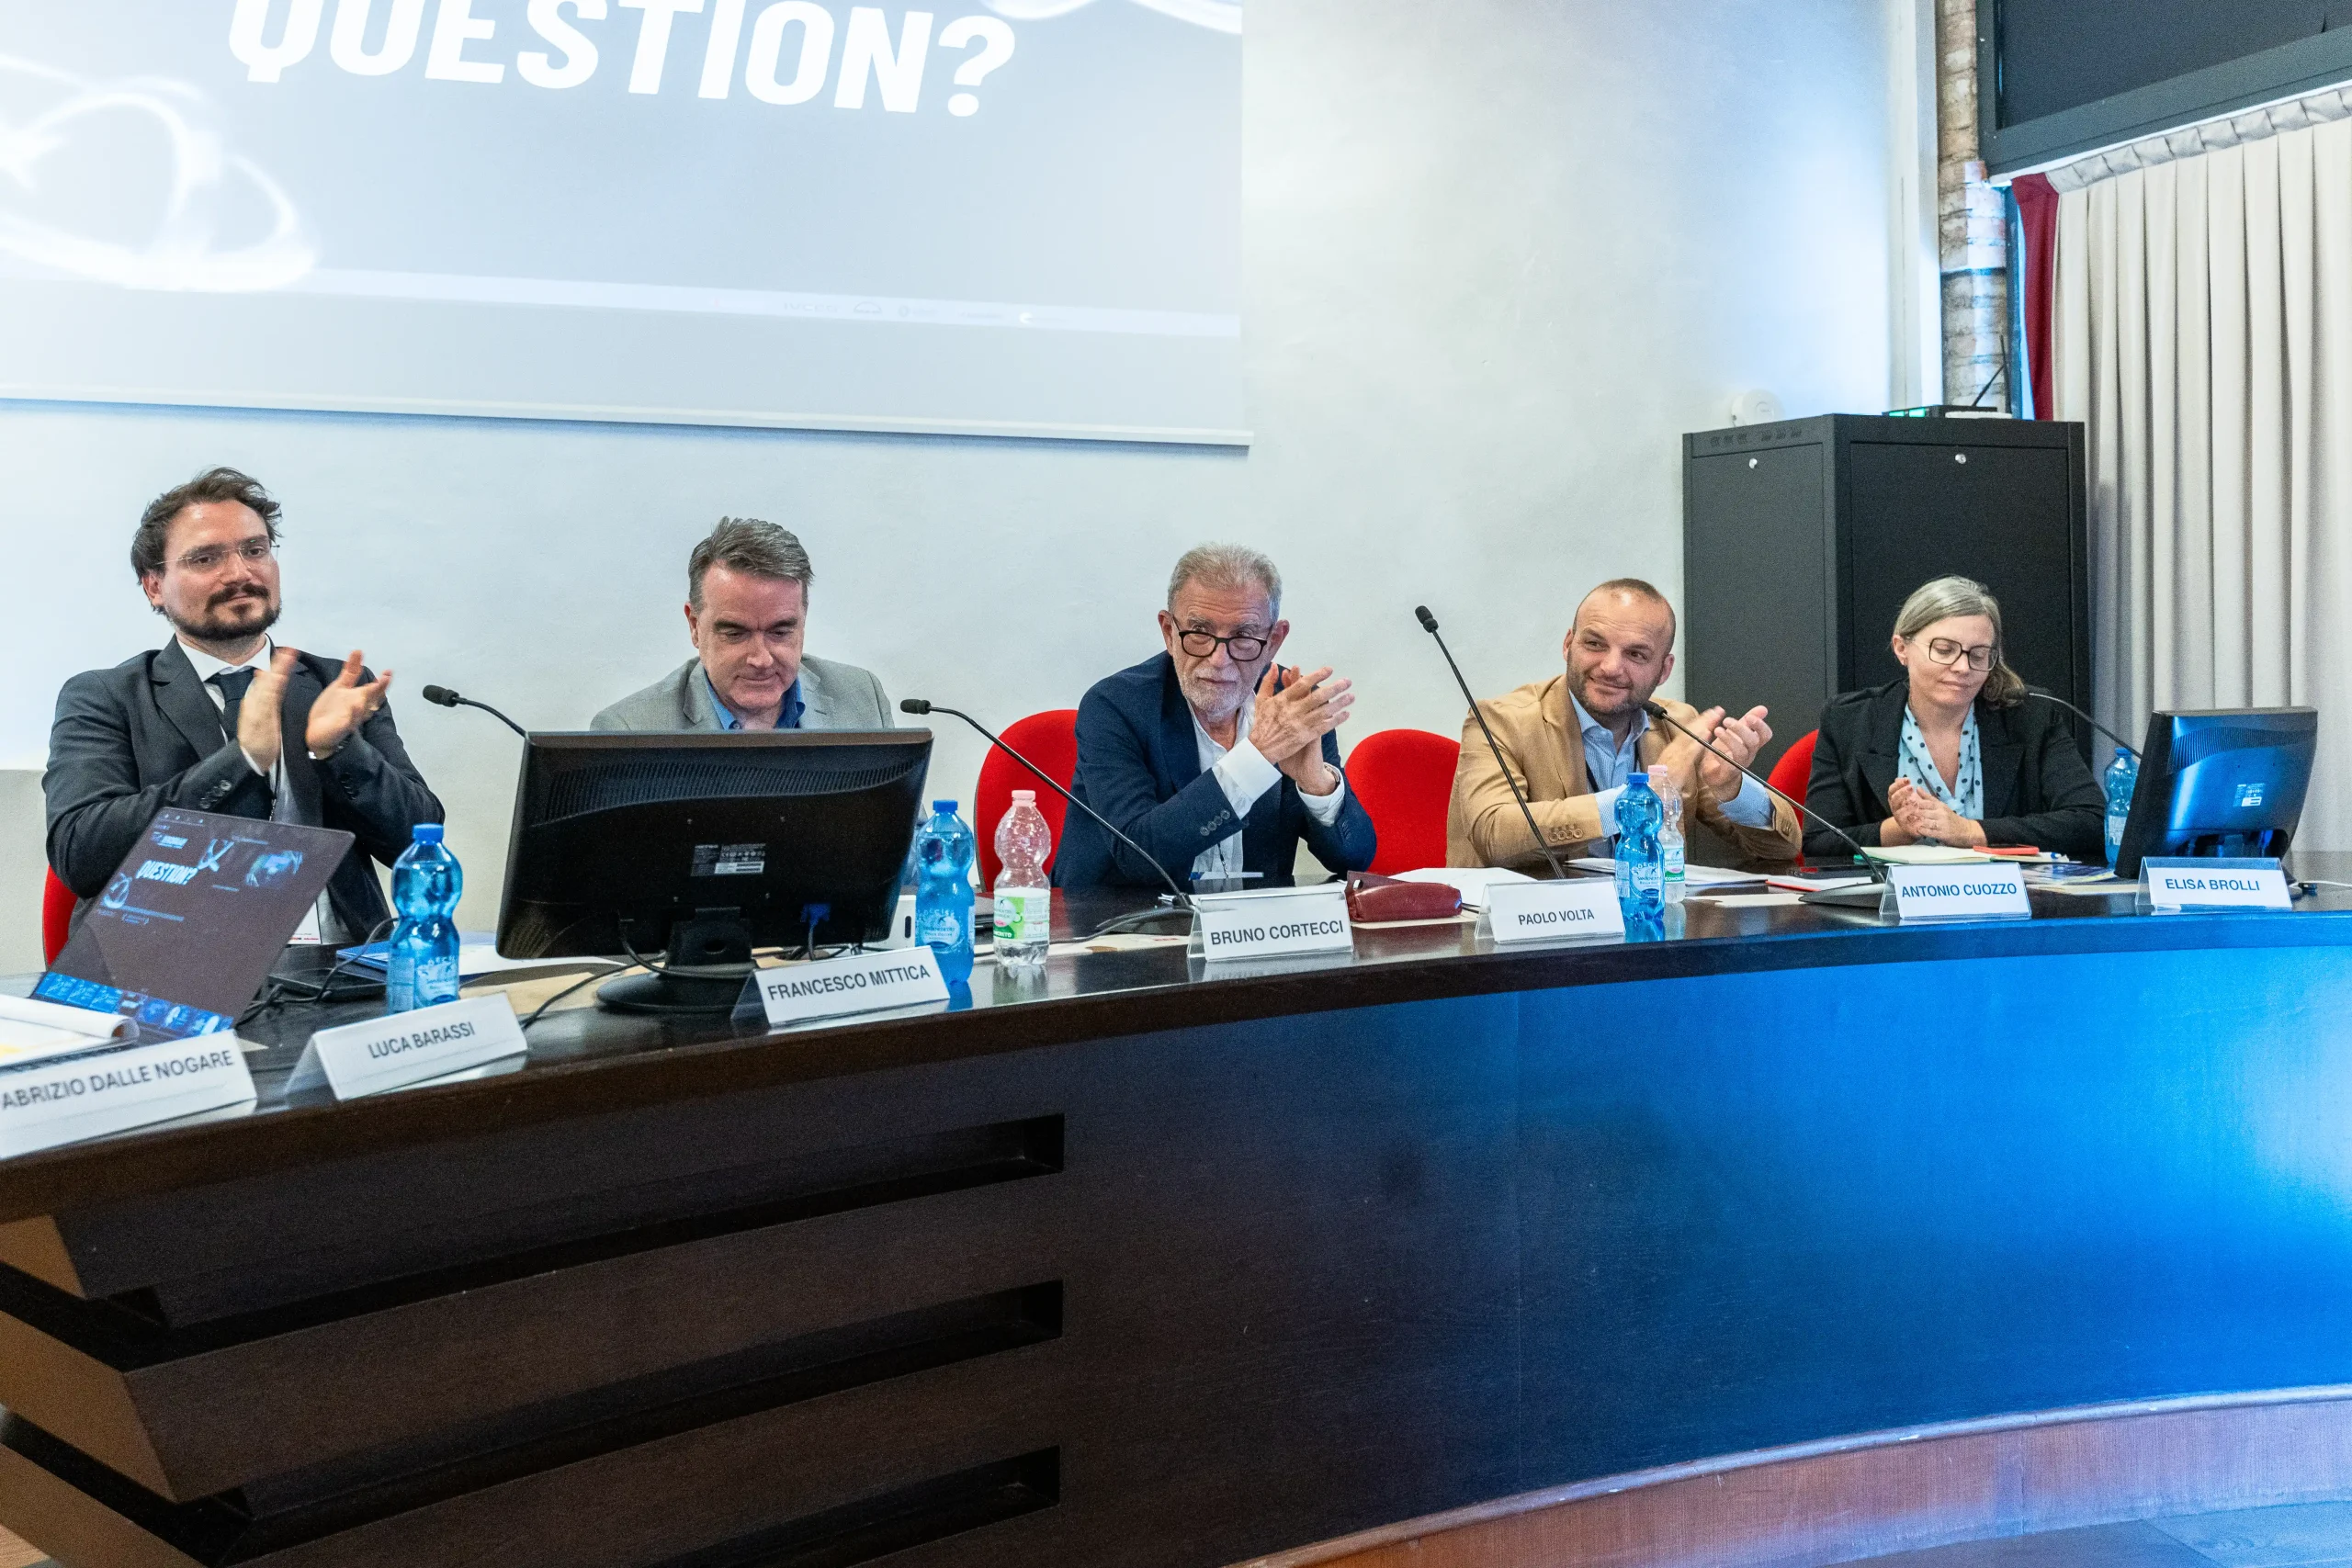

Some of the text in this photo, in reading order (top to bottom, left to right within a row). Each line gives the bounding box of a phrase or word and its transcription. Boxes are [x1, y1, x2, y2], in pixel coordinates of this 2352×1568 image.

[228, 0, 1015, 118] QUESTION?
[135, 860, 198, 886] QUESTION?
[2165, 878, 2260, 891] ELISA BROLLI
[1902, 883, 2017, 897] ANTONIO CUOZZO
[1518, 908, 1595, 925] PAOLO VOLTA
[1210, 919, 1344, 945] BRUNO CORTECCI
[767, 964, 931, 1001] FRANCESCO MITTICA
[368, 1021, 476, 1059] LUCA BARASSI
[0, 1050, 235, 1110] ABRIZIO DALLE NOGARE
